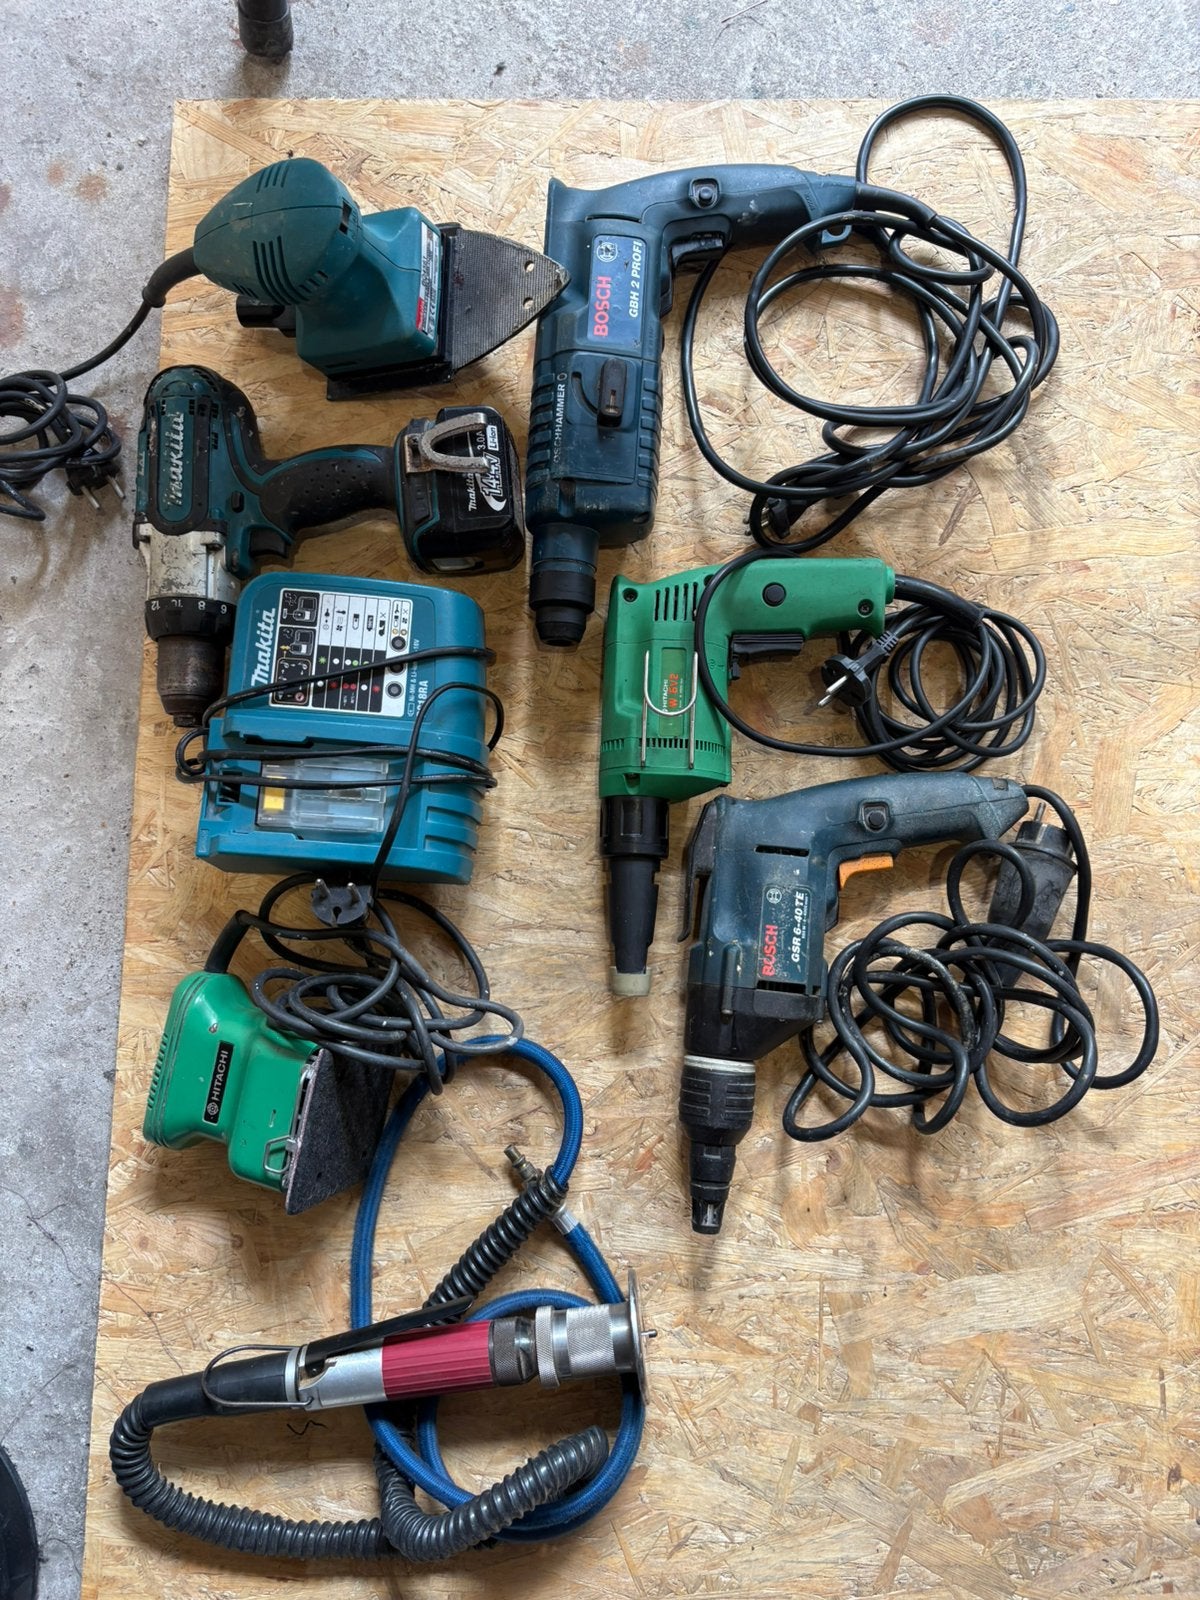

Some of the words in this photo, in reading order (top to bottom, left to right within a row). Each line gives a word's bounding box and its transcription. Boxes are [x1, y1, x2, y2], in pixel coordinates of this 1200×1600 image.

[631, 241, 642, 279] PROFI
[630, 281, 640, 289] 2
[593, 276, 612, 337] BOSCH
[629, 291, 640, 318] GBH
[553, 384, 566, 464] OSCHHAMMER
[476, 431, 486, 450] 3.0A
[151, 601, 161, 611] 12
[198, 601, 206, 610] 8
[220, 604, 228, 614] 6
[795, 891, 805, 908] TE
[793, 908, 803, 936] 6-40
[791, 937, 801, 963] GSR
[211, 1050, 229, 1101] HITACHI
